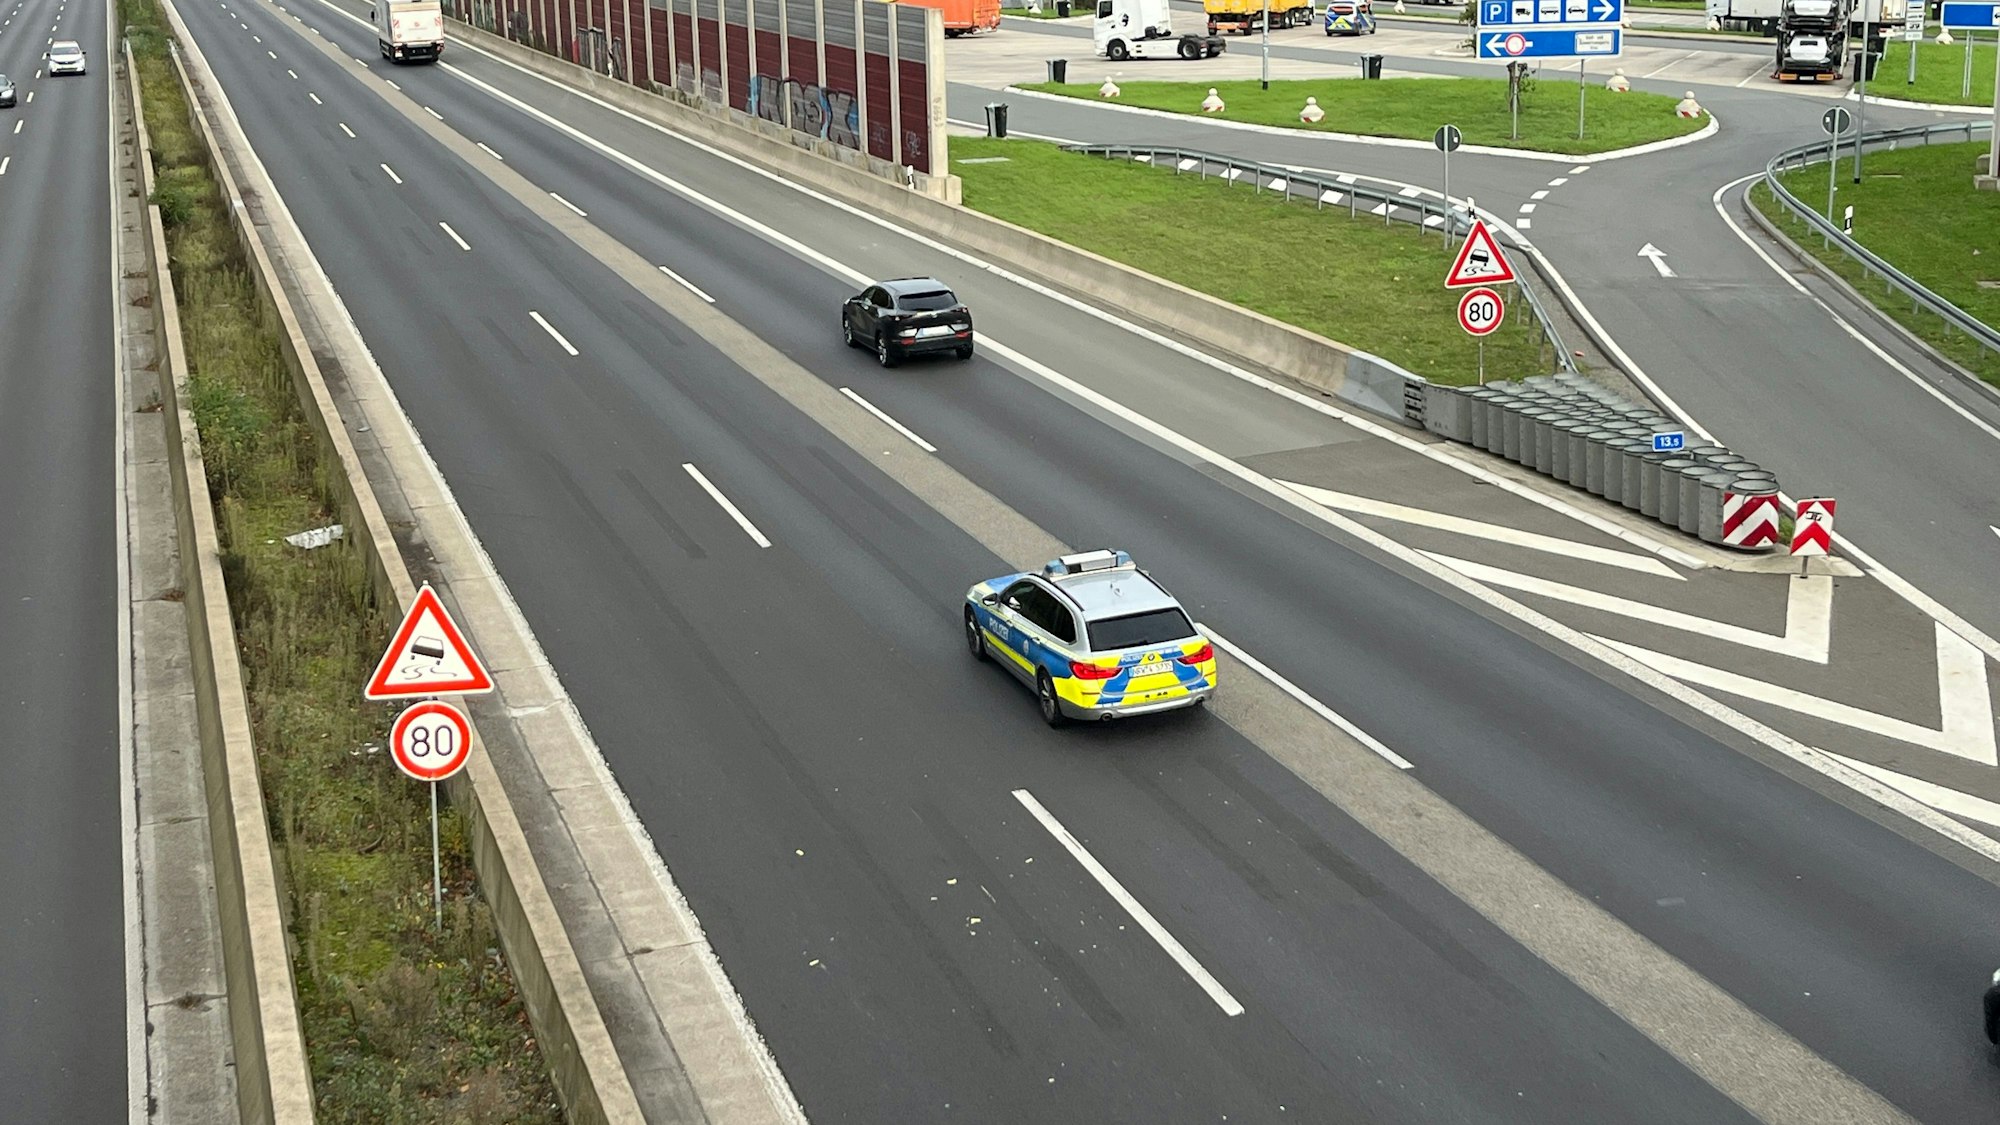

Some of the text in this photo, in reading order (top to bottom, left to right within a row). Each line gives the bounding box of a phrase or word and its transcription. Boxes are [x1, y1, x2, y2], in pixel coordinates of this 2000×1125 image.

[1490, 4, 1502, 21] P
[1469, 301, 1493, 322] 80
[411, 725, 453, 757] 80
